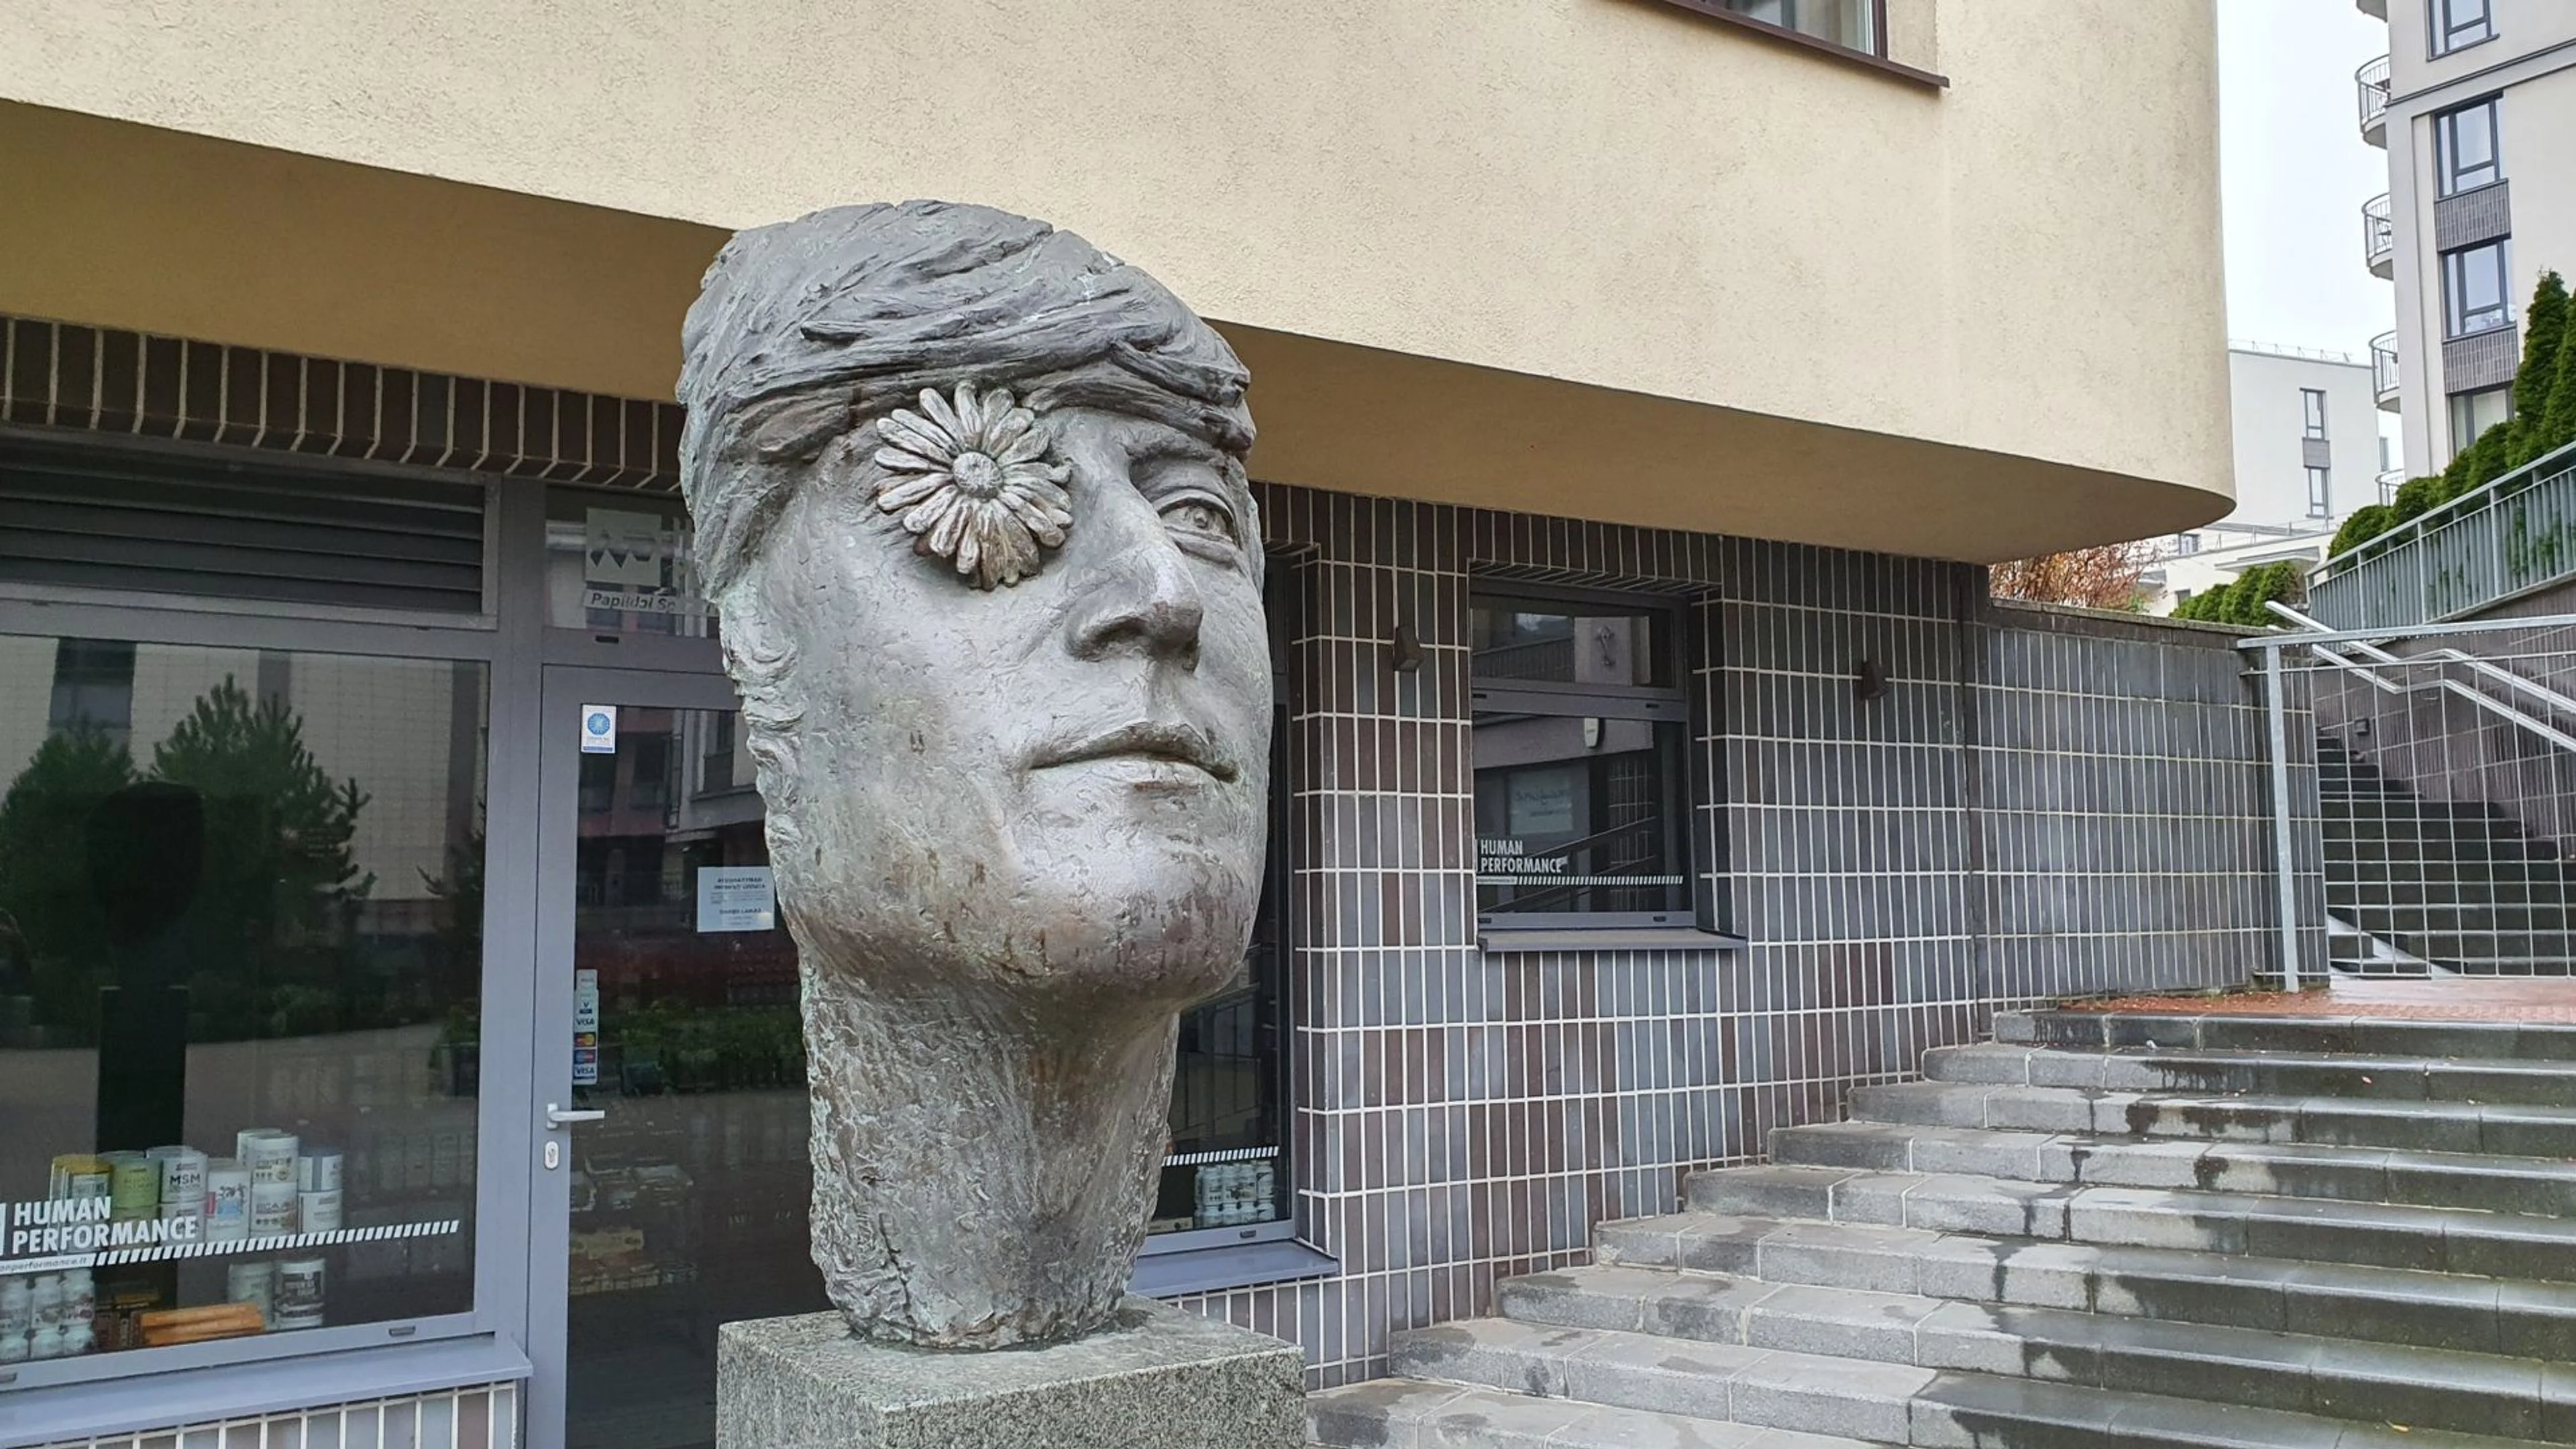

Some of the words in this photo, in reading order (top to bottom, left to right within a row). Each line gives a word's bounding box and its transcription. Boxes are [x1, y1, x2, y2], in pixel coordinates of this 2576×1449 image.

[1481, 839, 1523, 855] HUMAN
[1481, 857, 1562, 873] PERFORMANCE
[575, 1067, 594, 1075] VISA
[170, 1173, 201, 1185] MSM
[13, 1197, 111, 1226] HUMAN
[13, 1216, 197, 1254] PERFORMANCE
